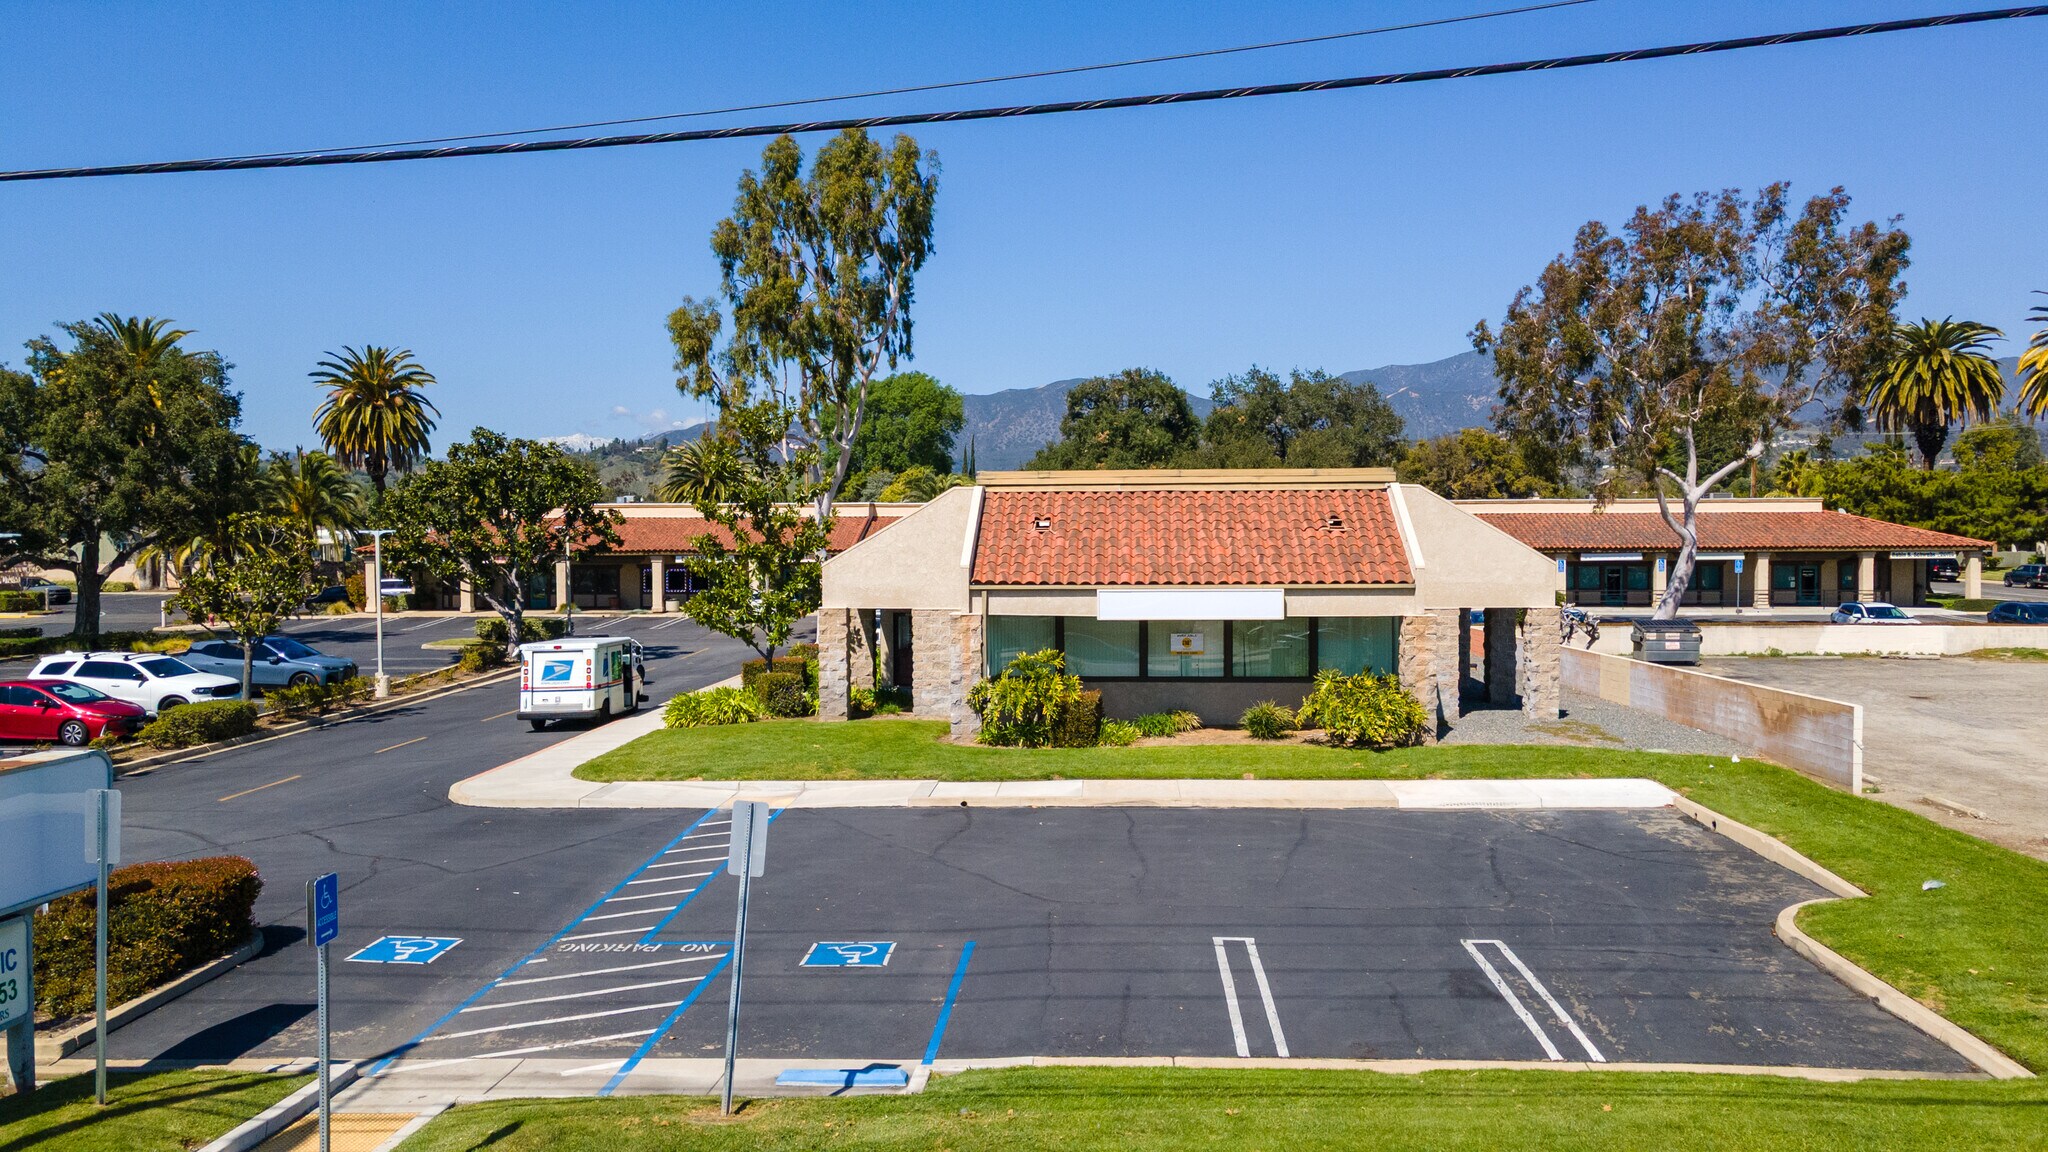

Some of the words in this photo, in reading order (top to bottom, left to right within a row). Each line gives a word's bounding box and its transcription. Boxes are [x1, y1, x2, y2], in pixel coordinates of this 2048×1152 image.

[317, 910, 337, 927] ACCESSIBLE
[558, 943, 663, 953] PARKING
[680, 943, 716, 953] NO
[0, 948, 17, 974] IC
[0, 978, 18, 1005] 53
